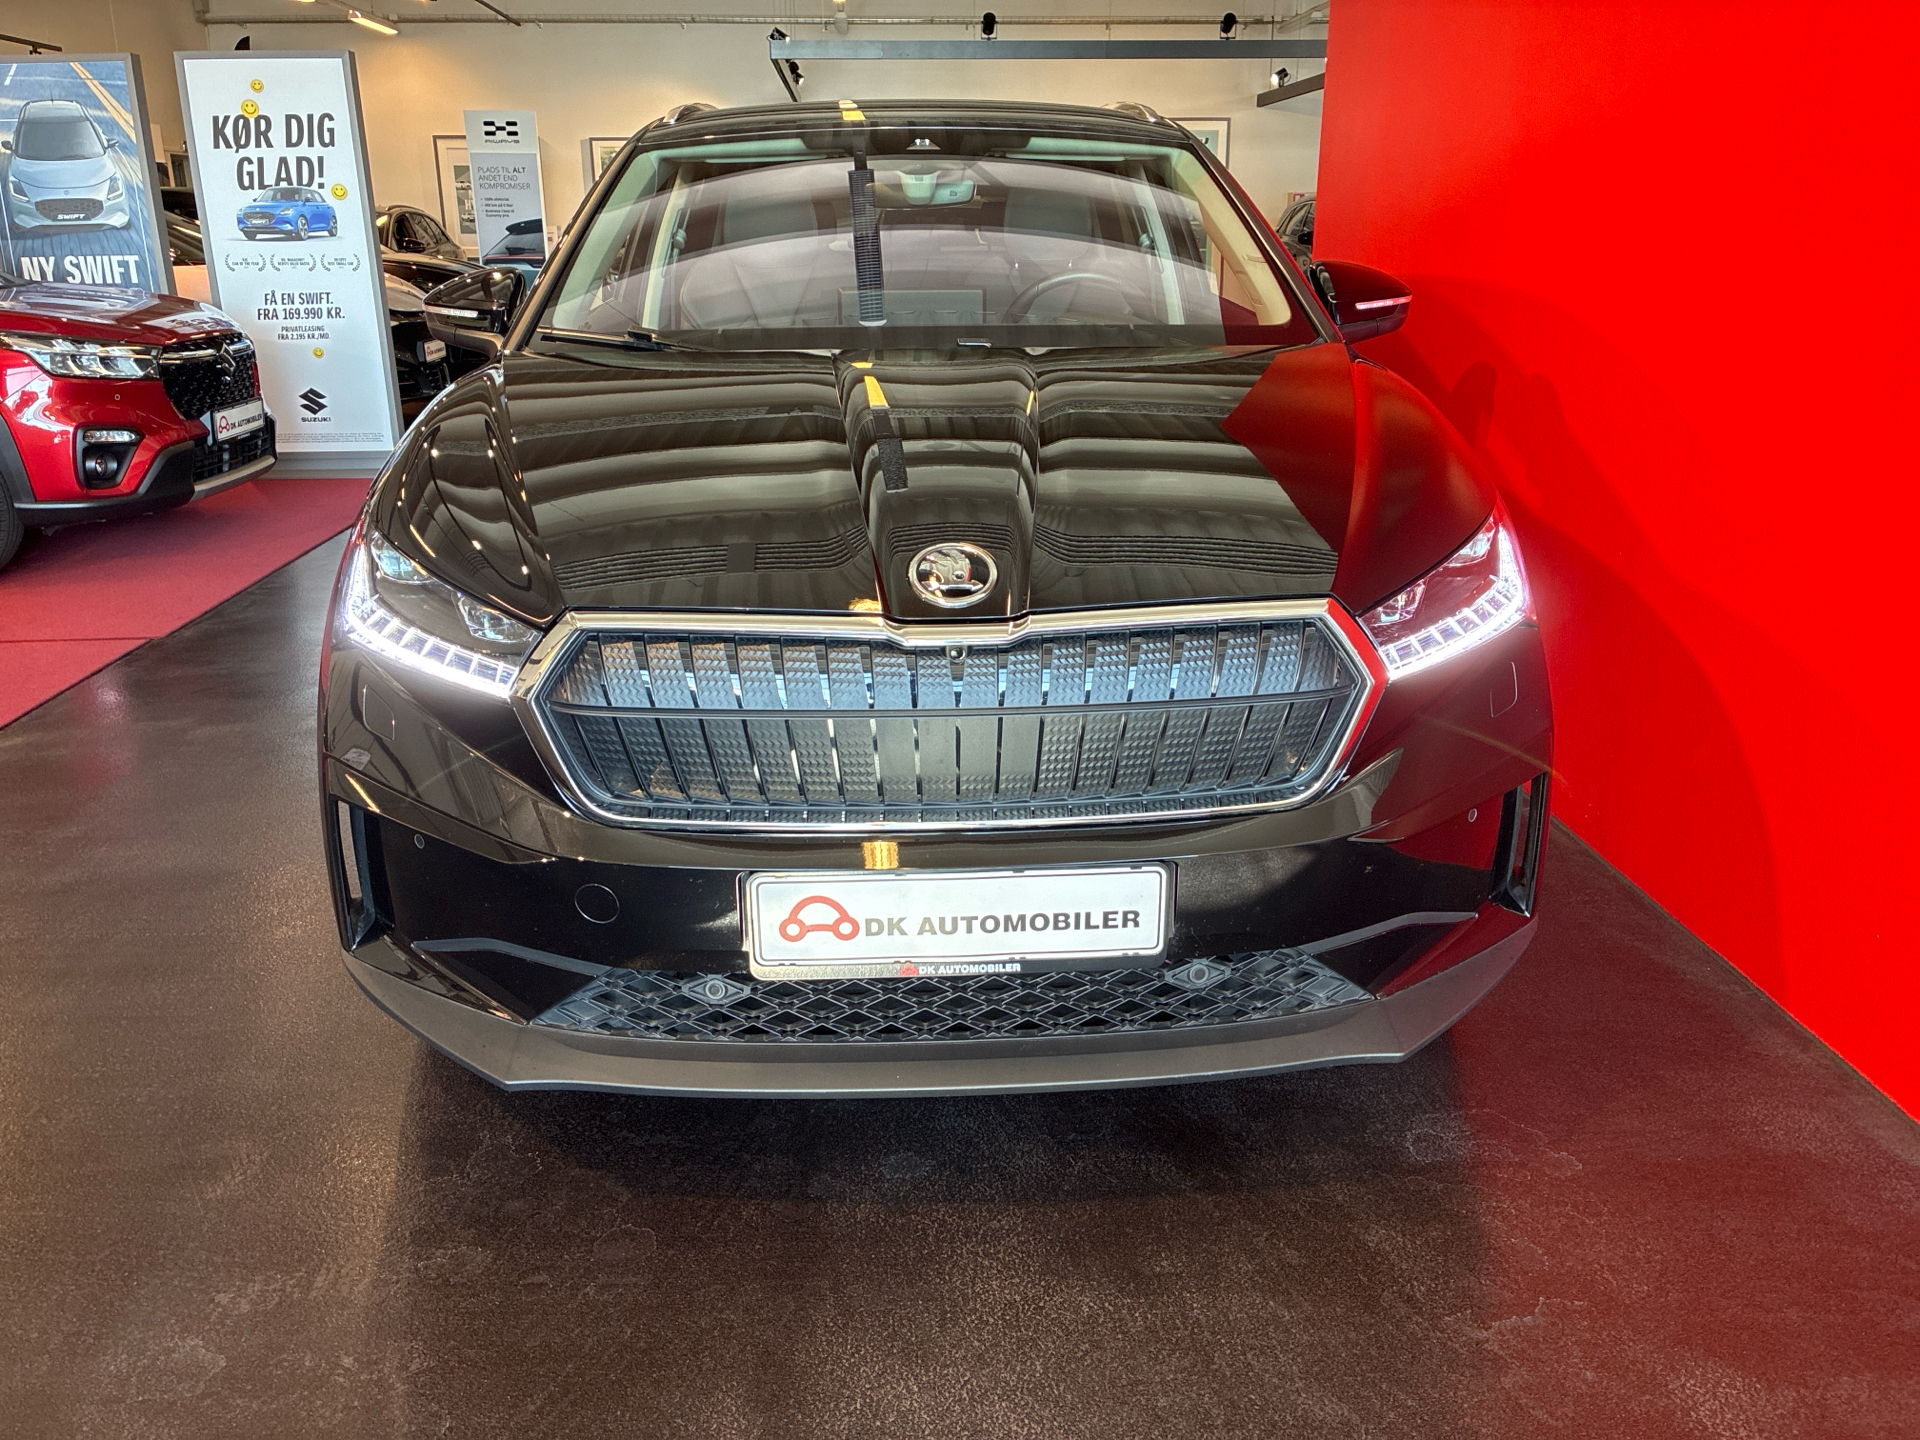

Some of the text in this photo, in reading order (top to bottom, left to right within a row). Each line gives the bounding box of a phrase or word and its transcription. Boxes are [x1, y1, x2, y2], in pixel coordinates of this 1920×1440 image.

[212, 112, 335, 153] KØR DIG
[236, 156, 325, 191] GLAD!
[477, 166, 526, 174] PLADS TIL ALT
[478, 174, 518, 182] ANDET END
[479, 182, 531, 190] KOMPROMISER
[20, 255, 140, 285] NY SWIFT
[264, 289, 334, 306] FÅ EN SWIFT.
[257, 306, 346, 321] FRA 169.990 KR.
[281, 325, 326, 333] PRIVATLEASING
[864, 910, 1141, 937] DK AUTOMOBILER
[918, 962, 1021, 975] DK AUTOMOBILER
